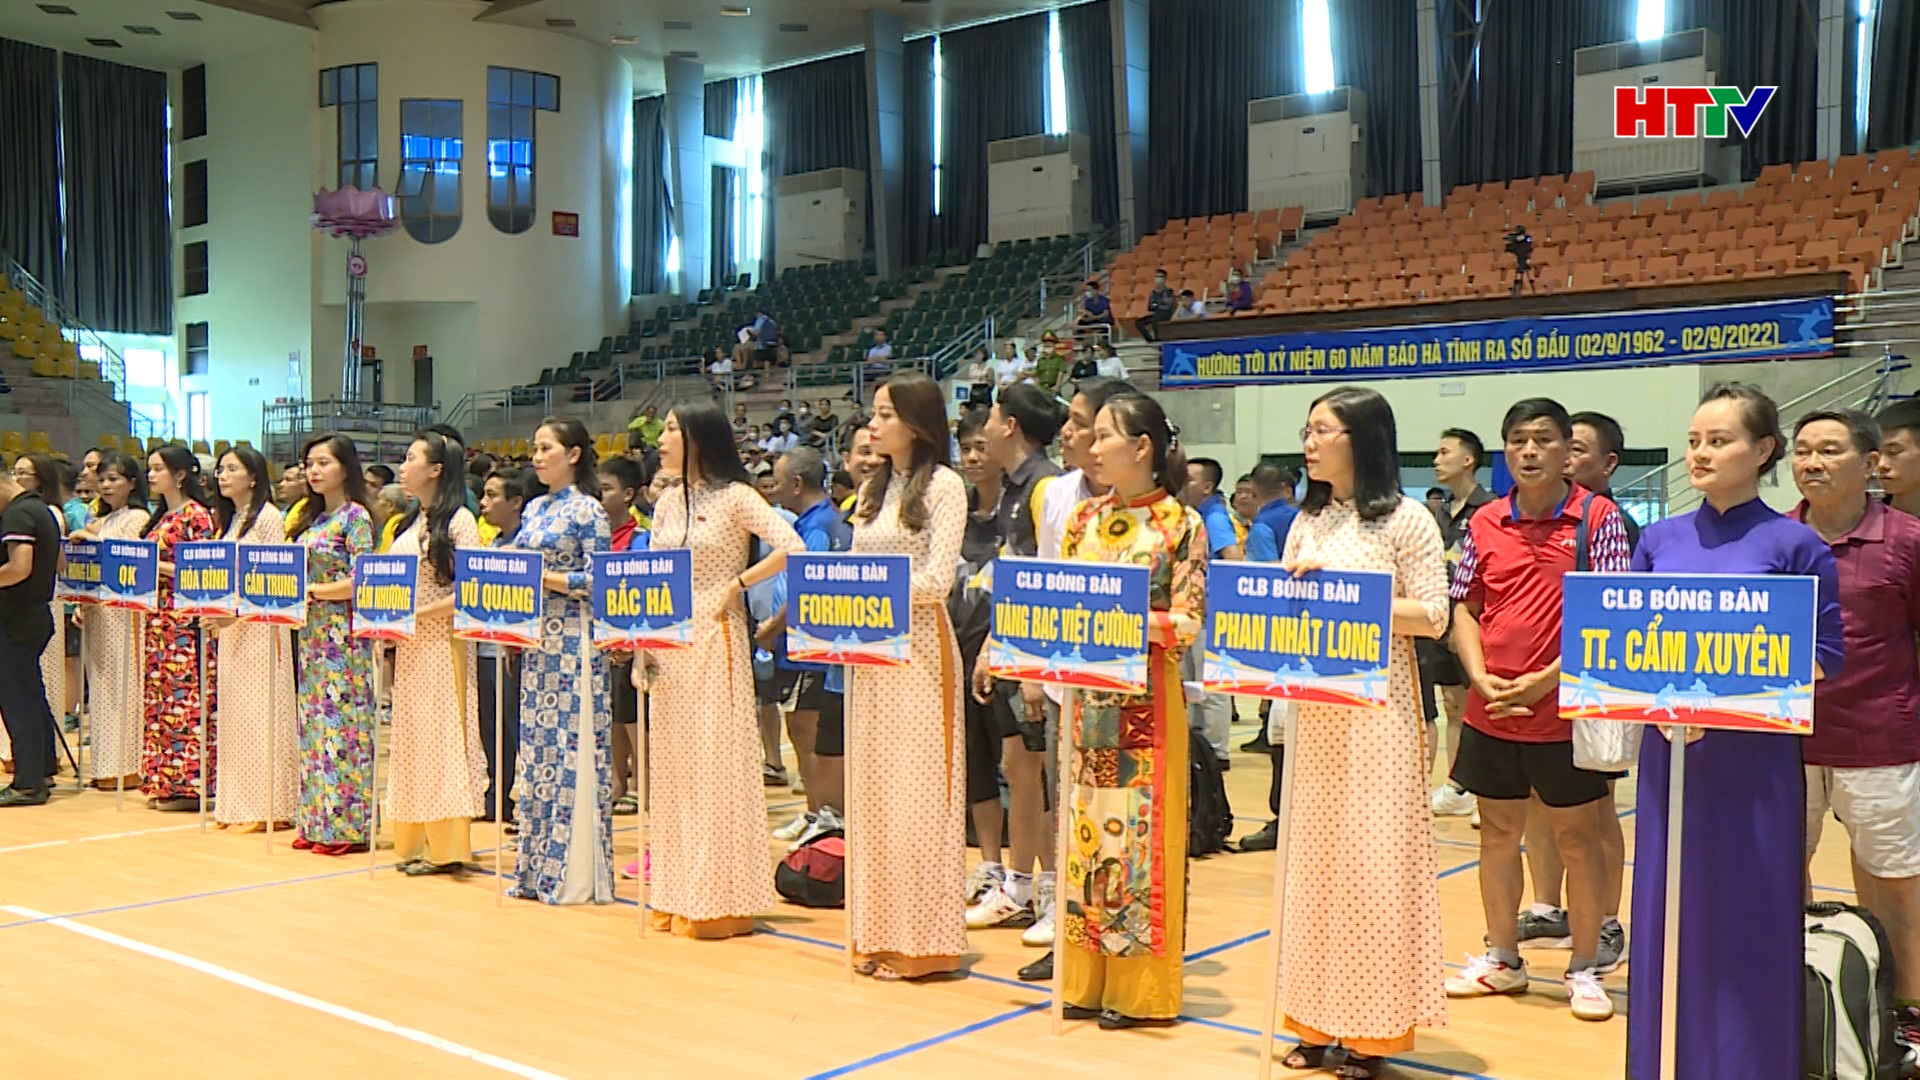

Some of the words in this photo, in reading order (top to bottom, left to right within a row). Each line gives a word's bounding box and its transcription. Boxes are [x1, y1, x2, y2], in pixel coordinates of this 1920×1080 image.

[1197, 350, 1241, 376] HƯỚNG
[1244, 348, 1265, 374] TỚI
[1289, 345, 1325, 376] NIỆM
[1329, 347, 1347, 369] 60
[1350, 341, 1384, 368] NĂM
[1388, 339, 1417, 366] BÁO
[1421, 337, 1442, 364] HÀ
[1446, 337, 1481, 362] TĨNH
[1485, 338, 1507, 361] RA
[1511, 330, 1532, 360] SỐ
[1536, 328, 1569, 359] ĐẦU
[1575, 329, 1665, 360] (02/9/1962
[1681, 321, 1780, 350] 02/9/2022)
[111, 545, 121, 555] CLB
[183, 549, 193, 560] CLB
[195, 547, 211, 560] BÓNG
[212, 546, 226, 560] BÀN
[248, 551, 260, 562] CLB
[261, 549, 278, 564] BÓNG
[279, 549, 294, 564] BÀN
[180, 564, 200, 590] HÒA
[201, 564, 229, 590] BÌNH
[363, 562, 373, 575] CLB
[468, 557, 483, 571] CLB
[485, 556, 507, 573] BÓNG
[508, 557, 528, 574] BÀN
[606, 561, 622, 576] CLB
[624, 558, 649, 576] BÓNG
[652, 557, 674, 574] BÀN
[804, 563, 825, 581] CLB
[828, 561, 859, 582] BÓNG
[861, 563, 888, 583] BÀN
[266, 573, 298, 598] TRUNG
[460, 577, 479, 607] VŨ
[481, 581, 534, 614] QUANG
[1016, 571, 1043, 590] CLB
[1046, 569, 1086, 593] BÓNG
[1089, 573, 1122, 596] BÀN
[1236, 576, 1269, 596] CLB
[1272, 574, 1319, 601] BÓNG
[1322, 577, 1361, 605] BÀN
[606, 578, 640, 616] BẮC
[646, 582, 674, 616] HÀ
[1601, 588, 1642, 611] CLB
[1649, 586, 1712, 612] BÓNG
[1719, 587, 1770, 613] BÀN
[799, 594, 895, 630] FORMOSA
[1031, 605, 1059, 648] BẠC
[1061, 601, 1091, 652] VIỆT
[1093, 603, 1144, 650] CƯỜNG
[1214, 610, 1267, 651] PHAN
[1271, 609, 1323, 663] NHẬT
[1326, 621, 1382, 664] LONG
[1581, 627, 1616, 671] TT.
[1626, 613, 1687, 673] CẨM
[1695, 624, 1791, 678] XUYÊN
